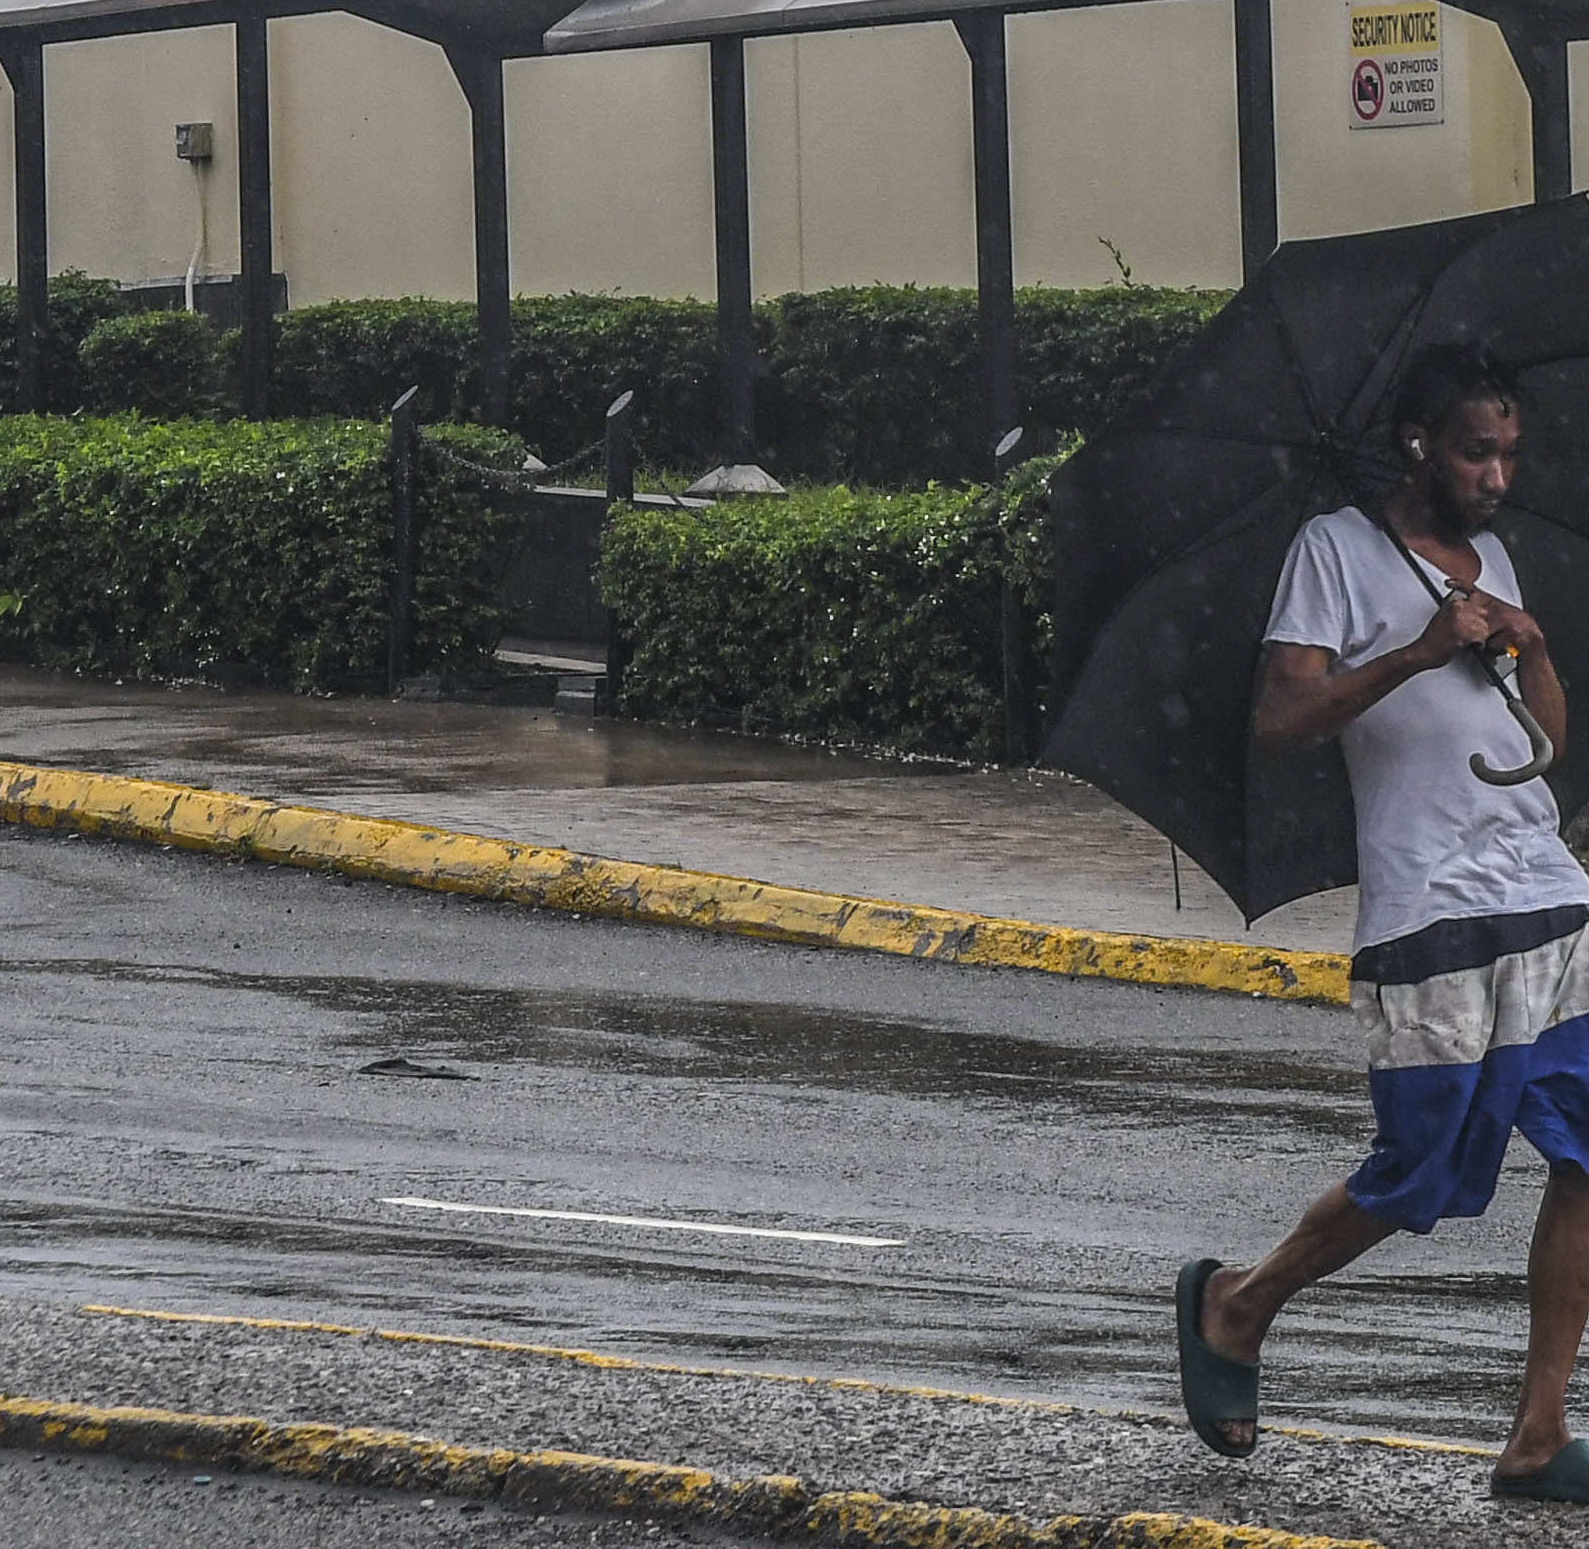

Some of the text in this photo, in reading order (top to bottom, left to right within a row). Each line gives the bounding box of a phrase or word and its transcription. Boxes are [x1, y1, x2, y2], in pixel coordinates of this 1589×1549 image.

[1352, 11, 1436, 47] SECURITY NOTICE
[1384, 58, 1438, 74] NO PHOTOS
[1389, 78, 1434, 94] OR VIDEO
[1390, 98, 1435, 113] ALLOWED
